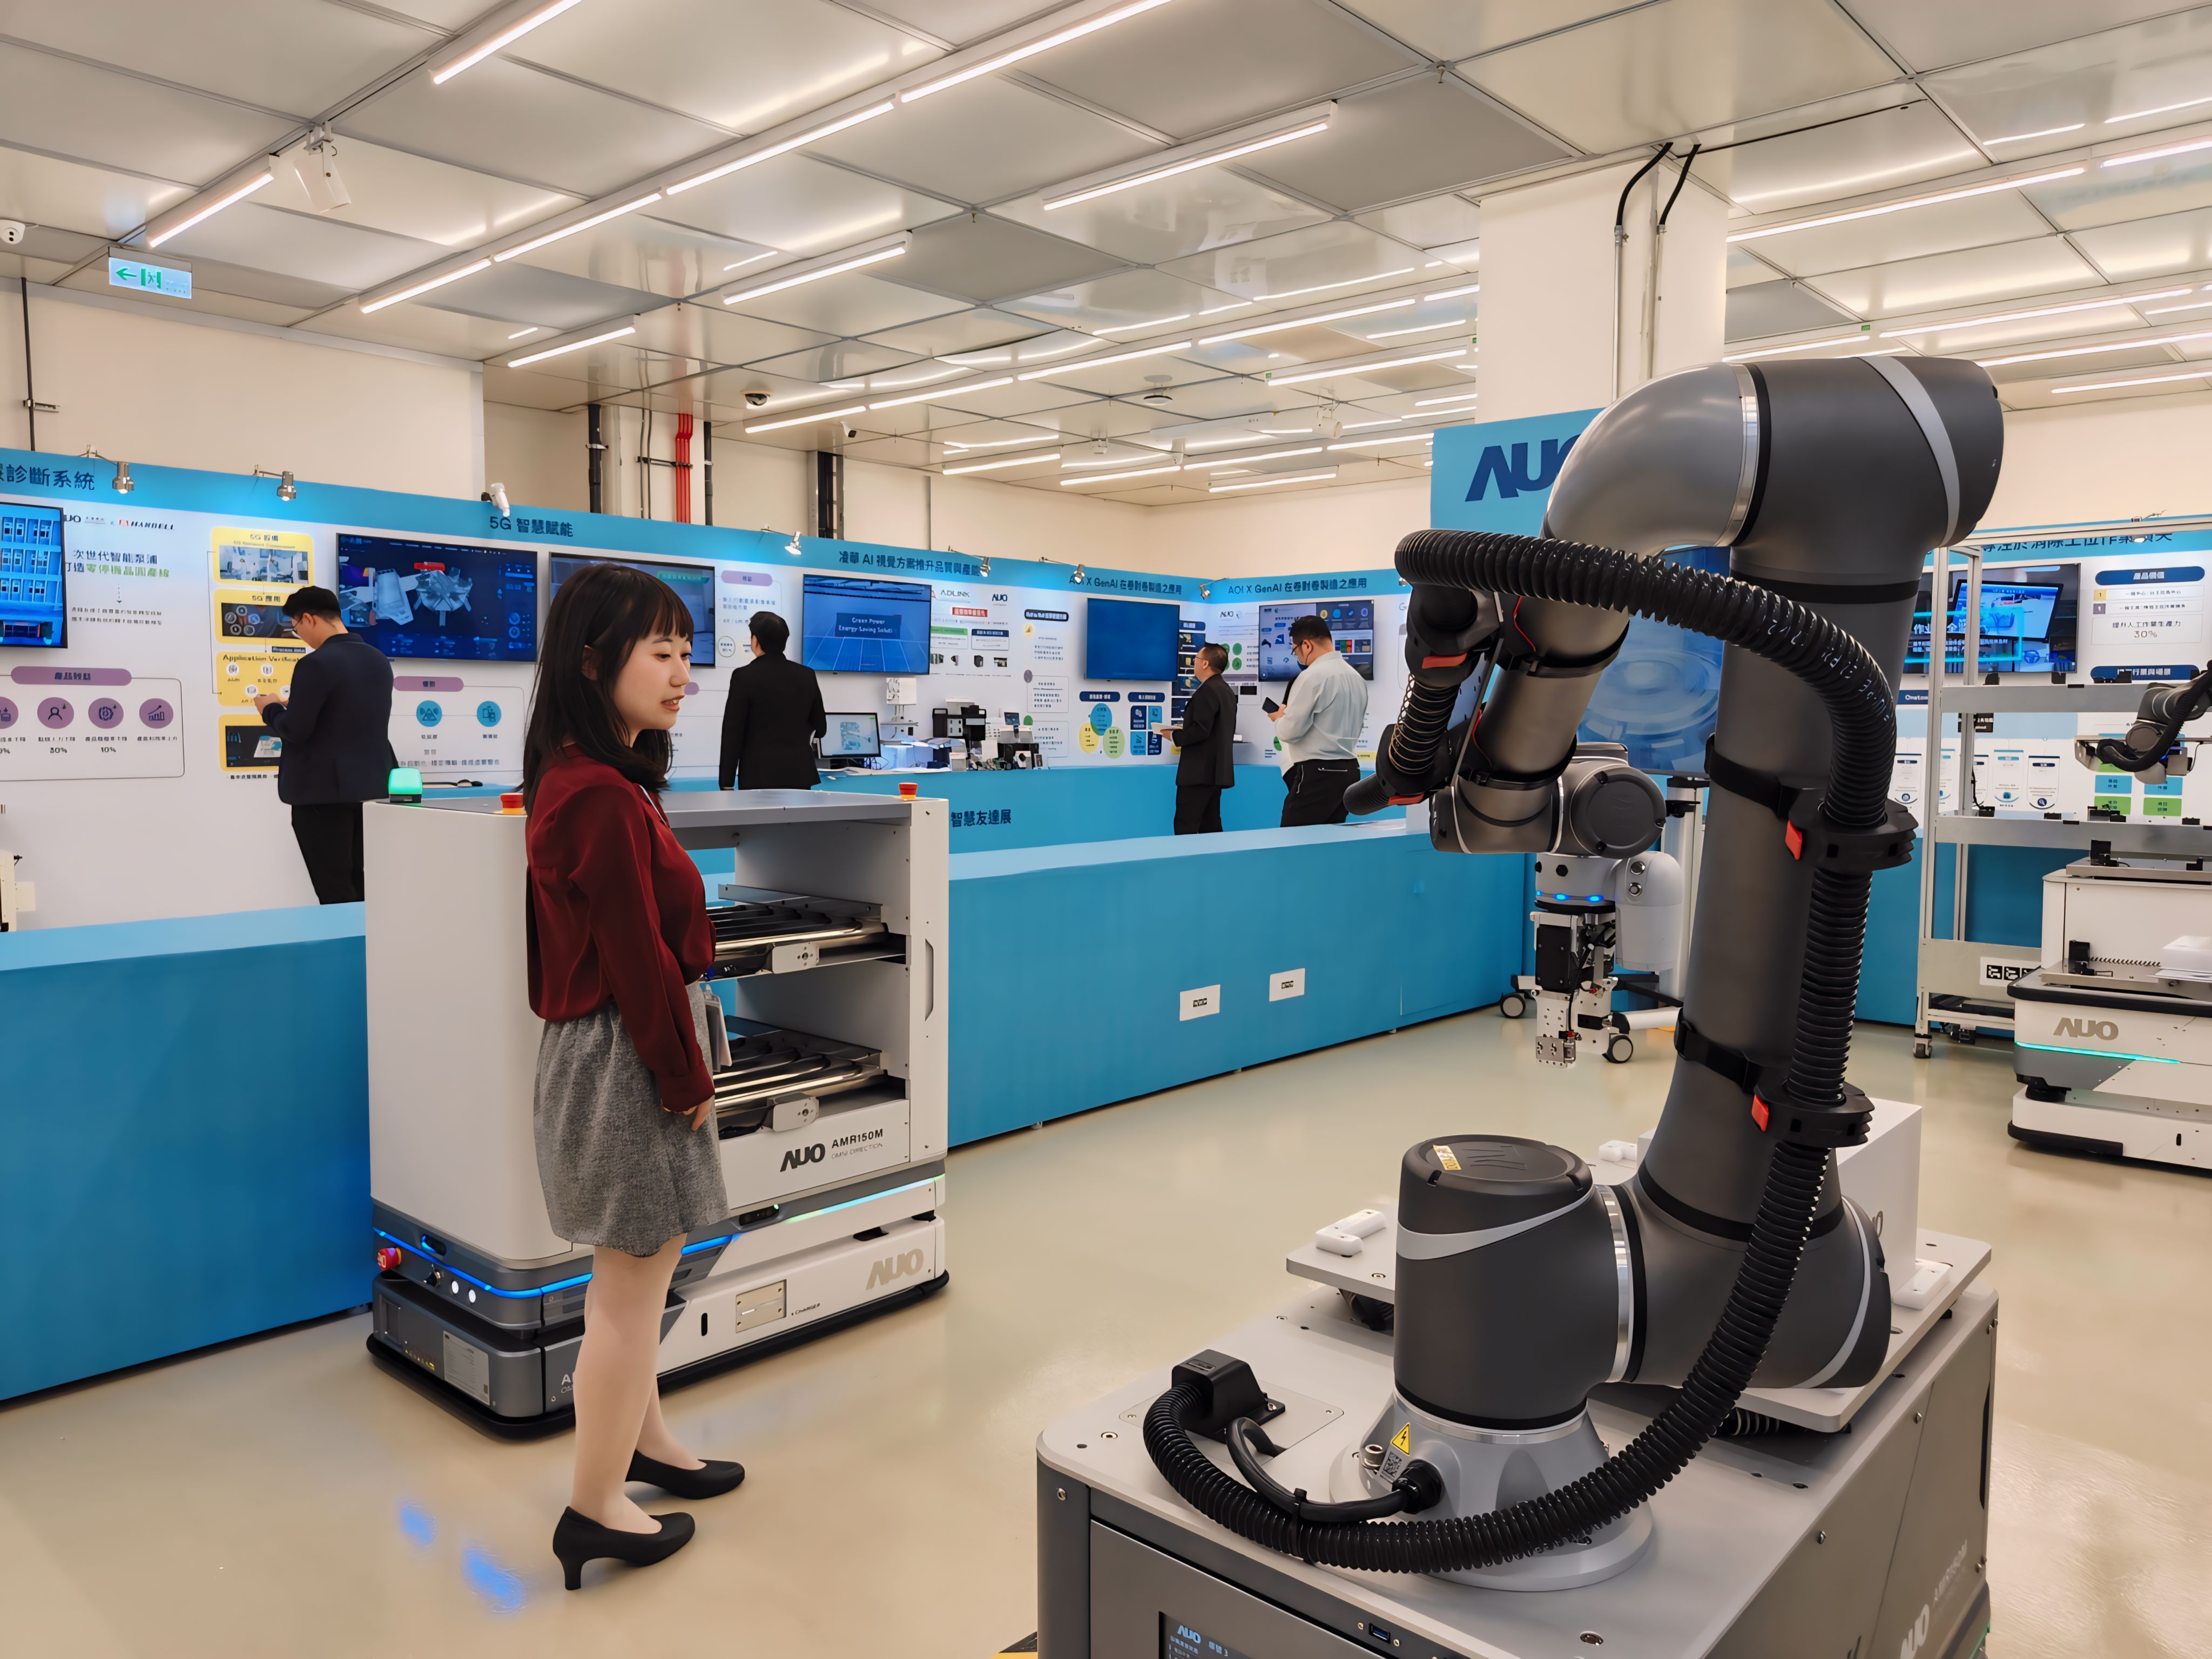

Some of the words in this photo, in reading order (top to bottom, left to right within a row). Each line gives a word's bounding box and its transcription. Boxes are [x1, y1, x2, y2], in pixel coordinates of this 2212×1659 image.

[490, 516, 511, 530] 5G
[516, 518, 573, 537] 智慧賦能
[862, 554, 873, 565] AI
[1087, 577, 1092, 586] X
[1094, 577, 1118, 588] GenAI
[1228, 586, 1243, 595] AOI
[1255, 584, 1282, 592] GenAI
[992, 594, 1008, 602] AUO
[951, 809, 1011, 827] 智慧友達展
[2053, 1017, 2119, 1041] AUO
[832, 1128, 883, 1149] AMR150M
[780, 1143, 826, 1172] AUO
[866, 1248, 924, 1290] AUO
[1177, 1625, 1201, 1644] AUO
